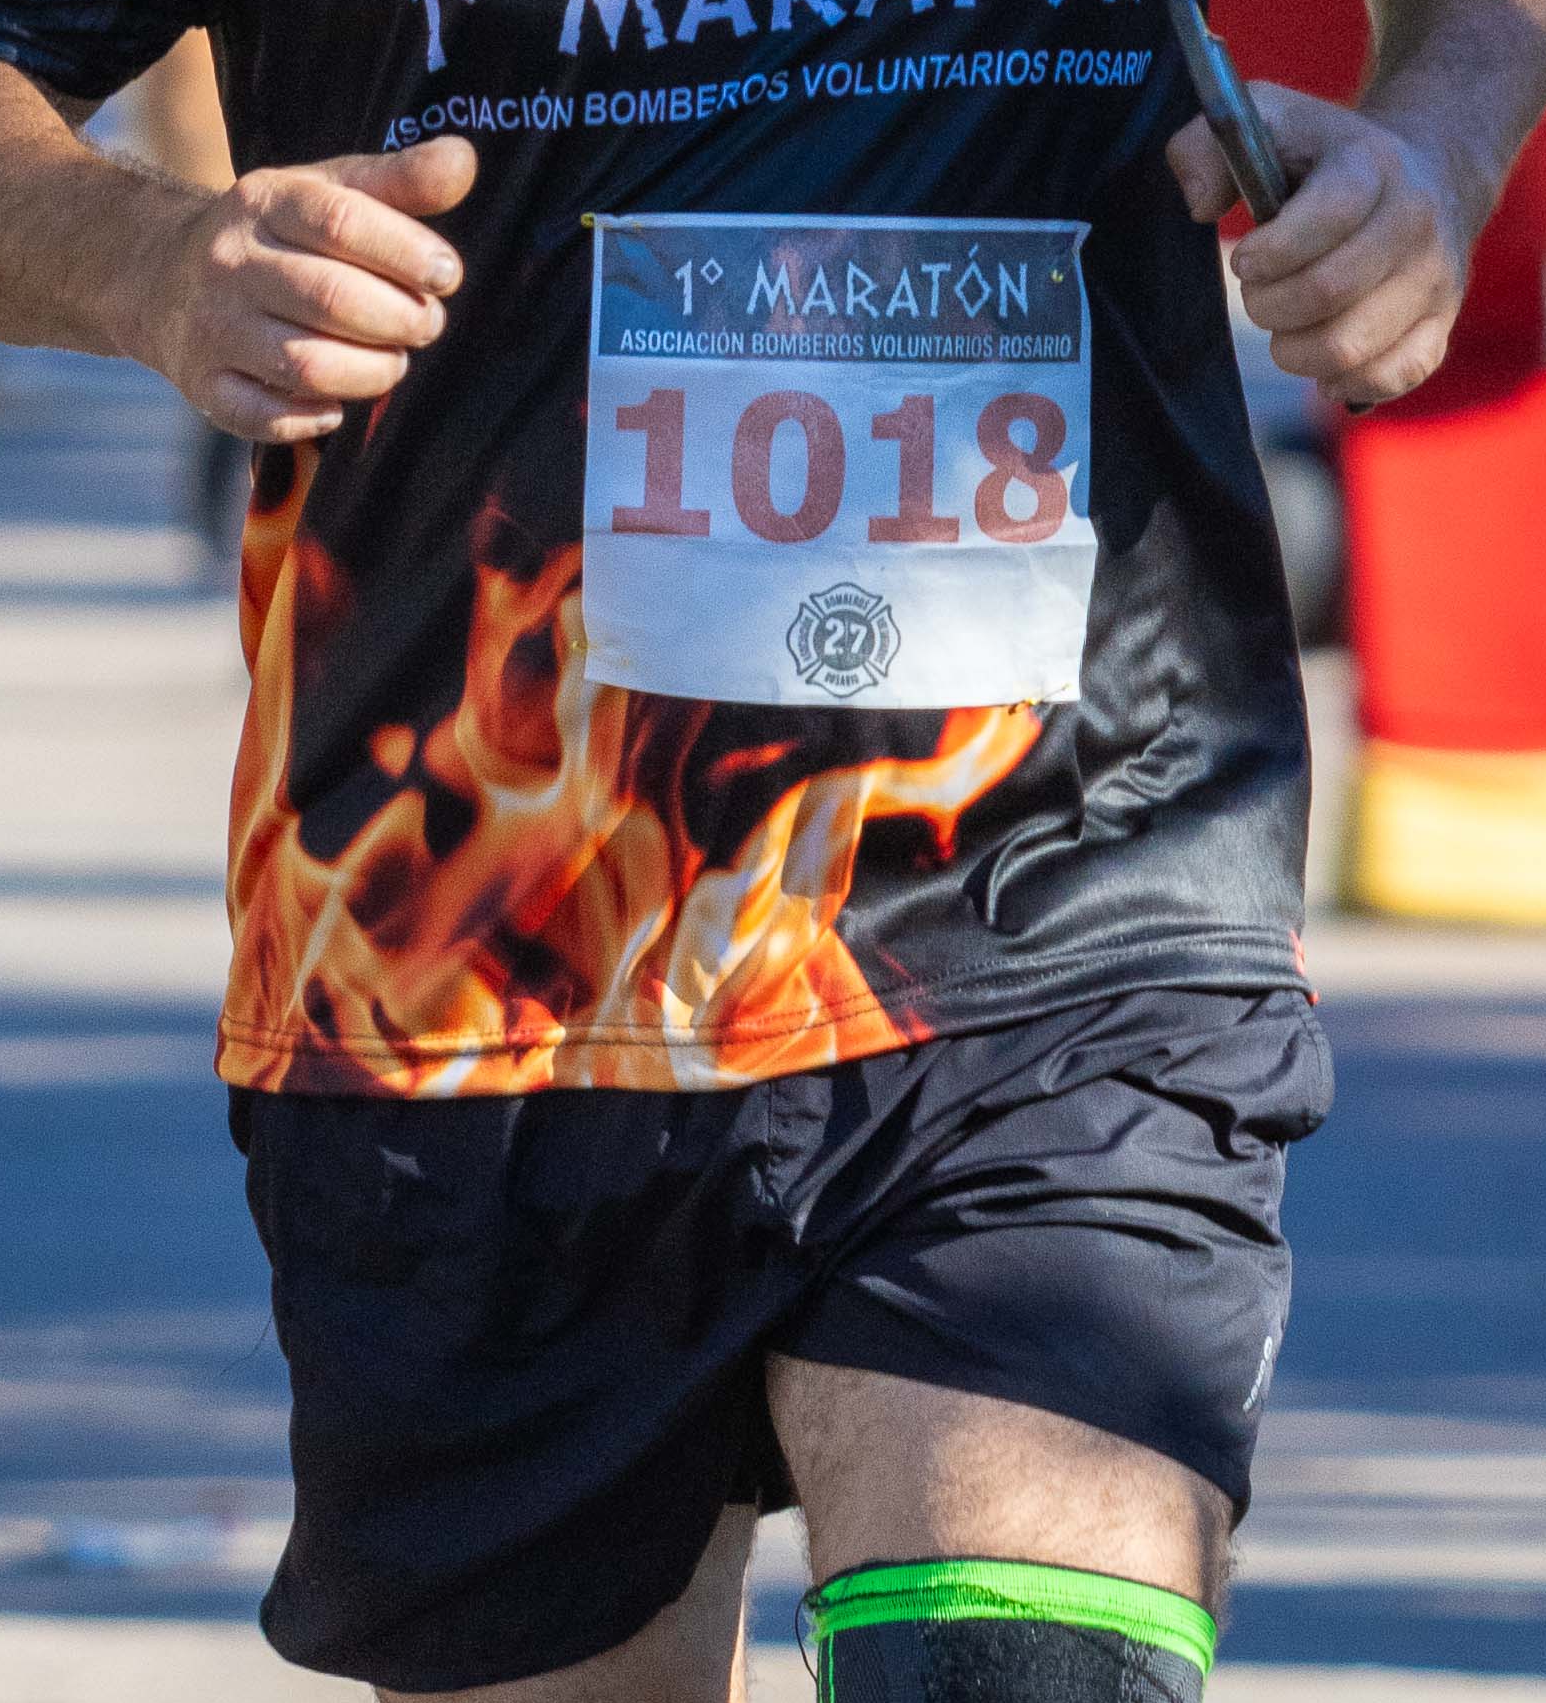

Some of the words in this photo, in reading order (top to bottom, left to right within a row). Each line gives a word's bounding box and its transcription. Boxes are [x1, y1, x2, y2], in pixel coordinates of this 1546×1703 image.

[383, 87, 575, 151] ASOCIACIÓN
[584, 70, 790, 126] BOMBEROS
[803, 48, 1048, 98] VOLUNTARIOS
[746, 243, 1030, 320] MARATÓN
[620, 324, 745, 354] ASOCIACIÓN
[751, 332, 863, 357] BOMBEROS
[870, 333, 993, 359] VOLUNTARIOS
[998, 336, 1073, 360] ROSARIO
[611, 388, 1069, 544] 1018
[823, 616, 867, 656] 27
